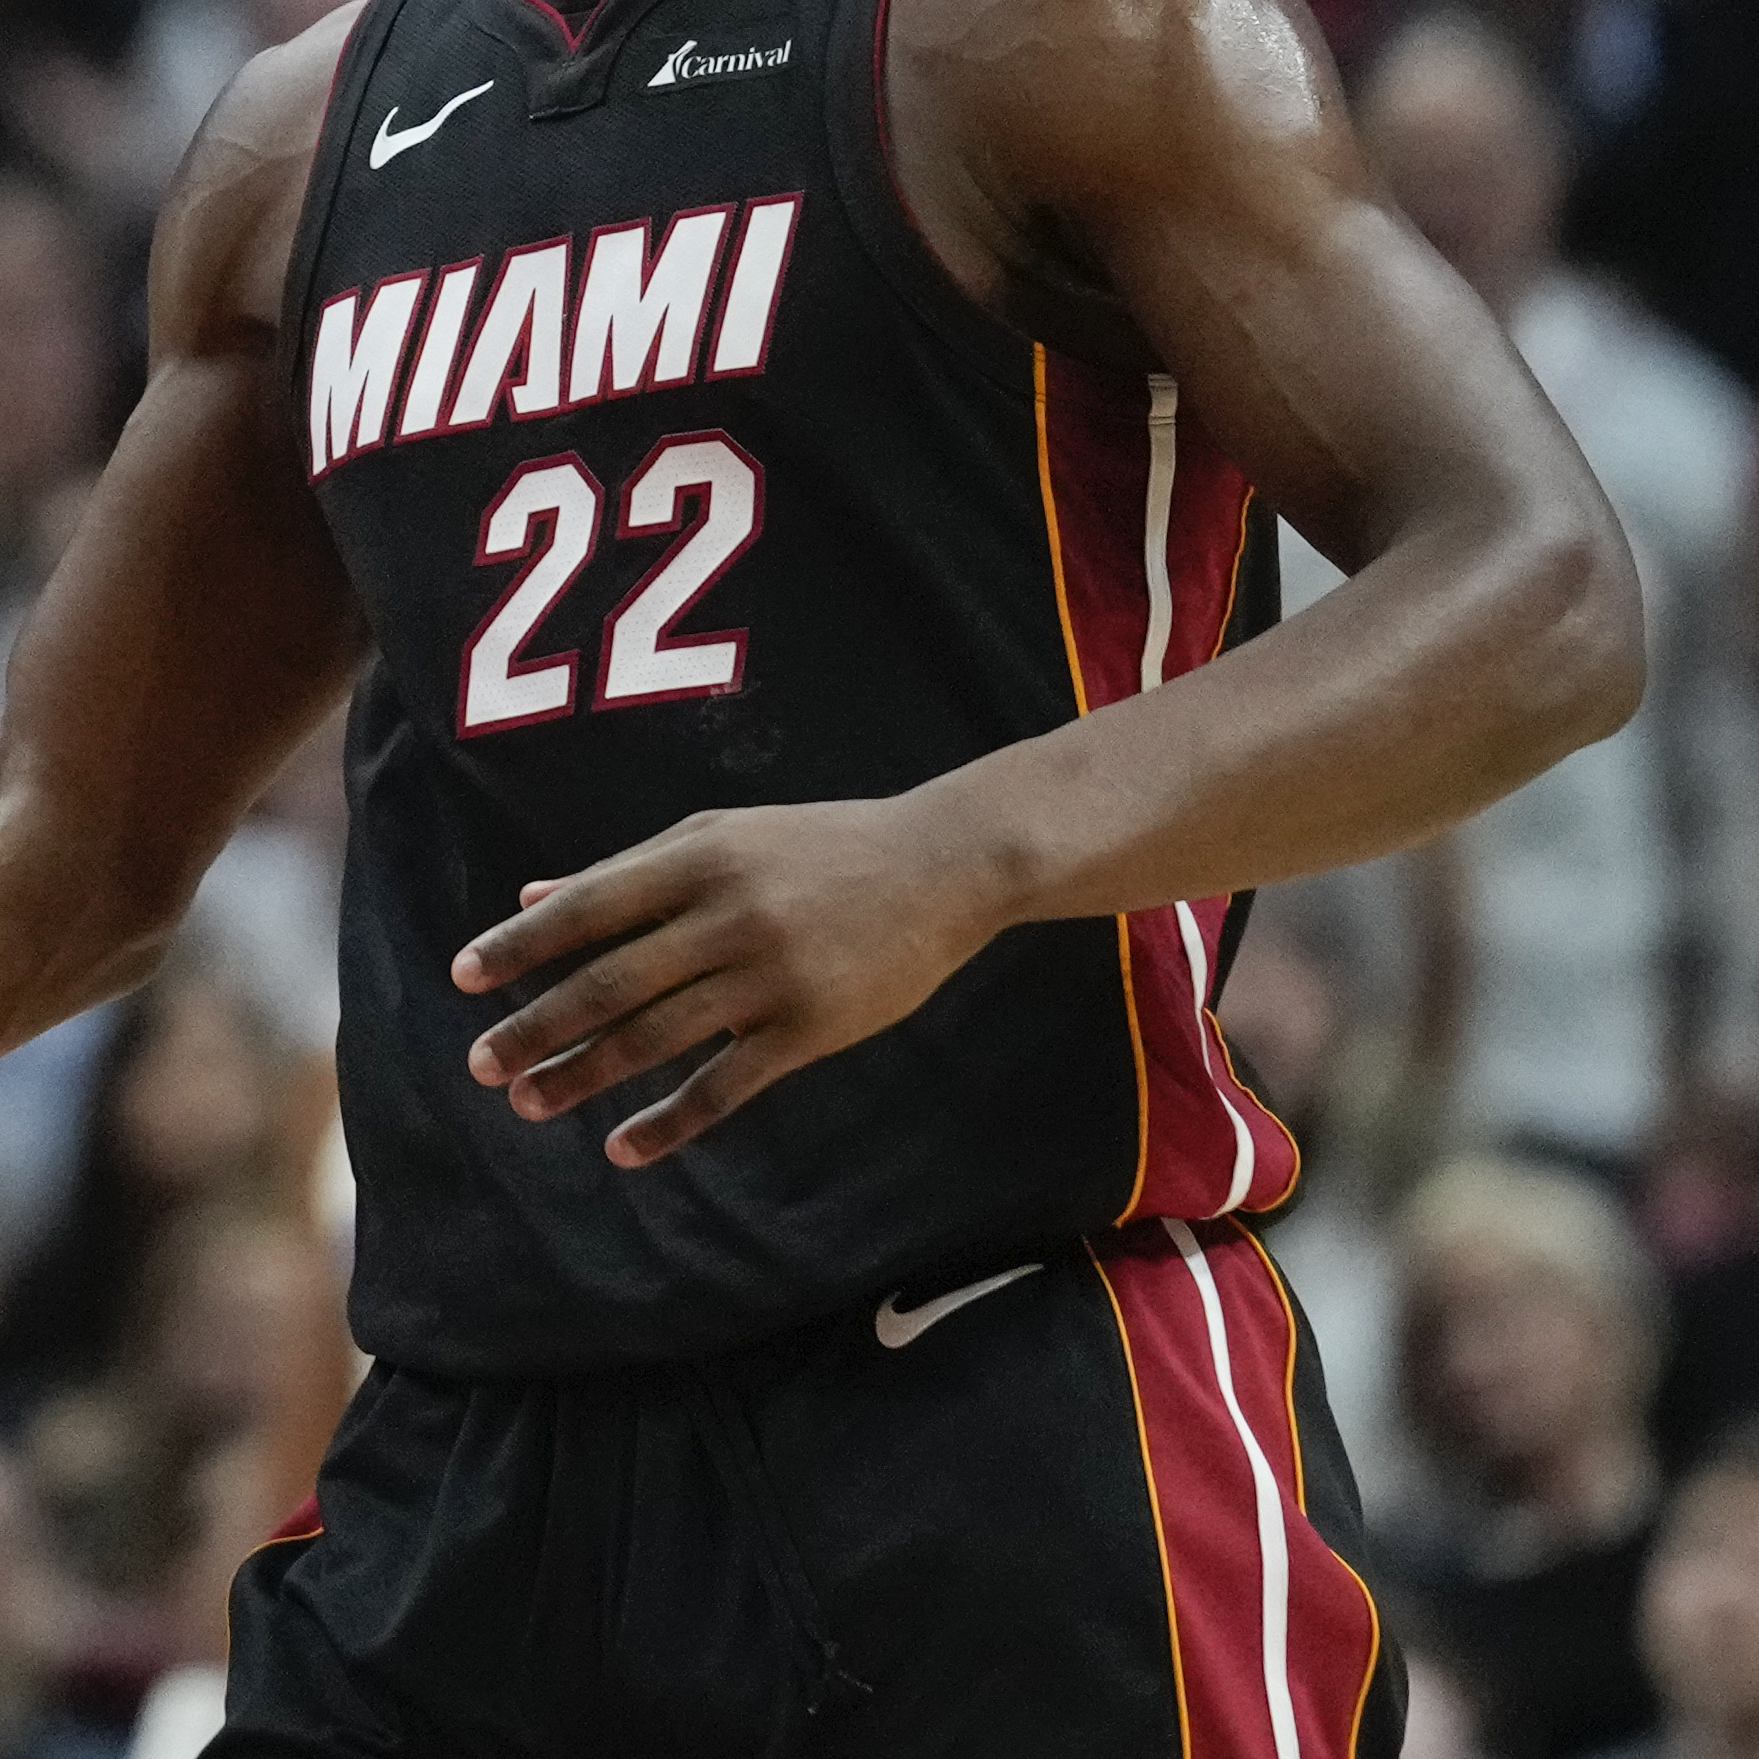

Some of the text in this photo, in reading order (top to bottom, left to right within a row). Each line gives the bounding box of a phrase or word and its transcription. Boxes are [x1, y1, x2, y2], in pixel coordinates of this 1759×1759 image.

[681, 39, 792, 79] Carnival
[308, 190, 804, 485] MIAMI
[456, 428, 765, 740] 22
